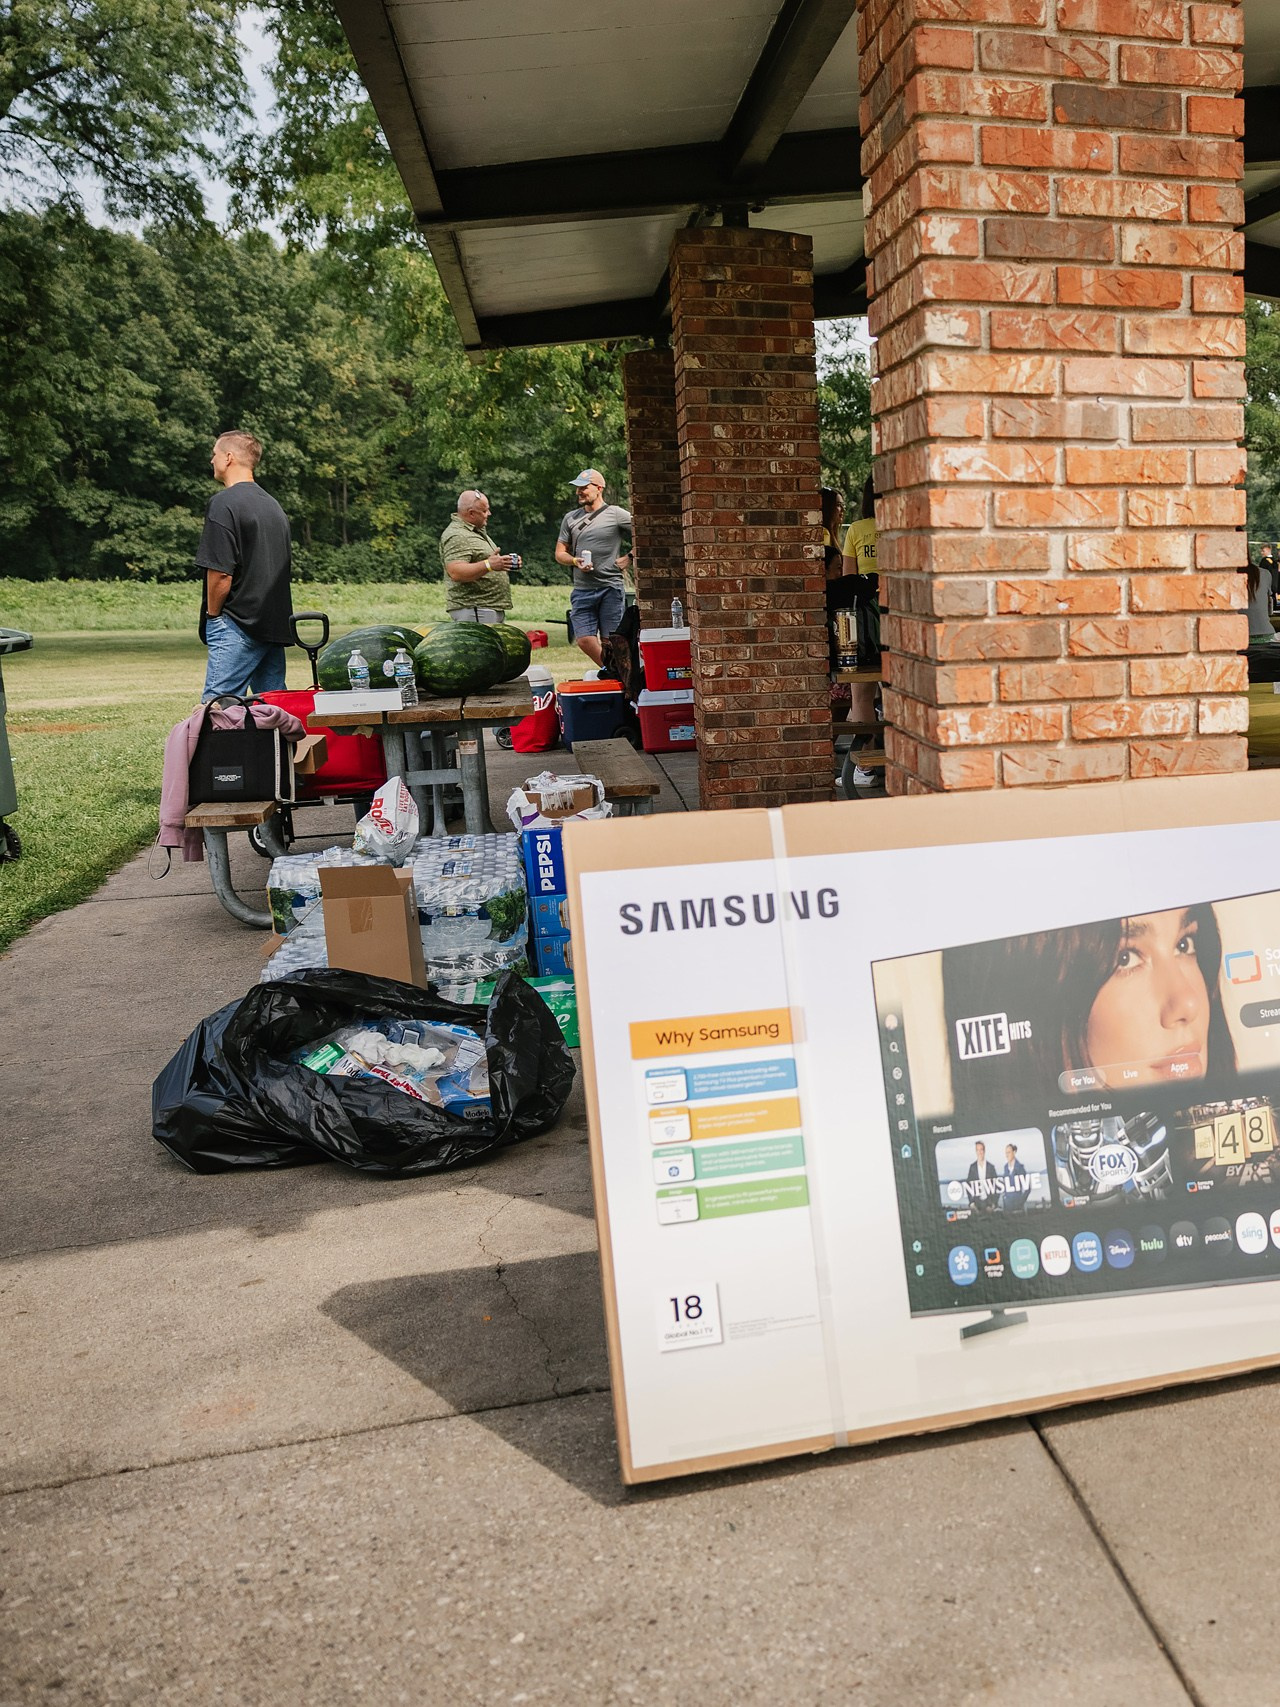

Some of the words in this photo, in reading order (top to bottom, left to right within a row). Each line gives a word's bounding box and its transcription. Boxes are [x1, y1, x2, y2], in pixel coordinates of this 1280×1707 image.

[536, 834, 556, 892] PEPSI
[620, 888, 840, 935] SAMSUNG
[656, 1031, 694, 1047] Why
[700, 1022, 780, 1042] Samsung
[1009, 1020, 1032, 1040] HITS
[960, 1018, 1006, 1056] XITE
[1123, 1070, 1138, 1079] Live
[1170, 1063, 1189, 1074] Apps
[1070, 1077, 1082, 1086] For
[1083, 1076, 1096, 1086] You
[1048, 1104, 1090, 1118] Recommended
[1100, 1102, 1112, 1110] You
[1098, 1152, 1126, 1170] FOX
[1100, 1168, 1129, 1178] SPORTS
[1226, 1163, 1244, 1176] BY
[1204, 1232, 1230, 1244] peacock
[1242, 1227, 1263, 1240] sling
[1077, 1240, 1096, 1250] prime
[1140, 1238, 1164, 1251] hulu
[1044, 1249, 1068, 1260] NETFLIX
[1078, 1249, 1098, 1258] video
[670, 1295, 702, 1322] 18
[664, 1330, 688, 1340] Global
